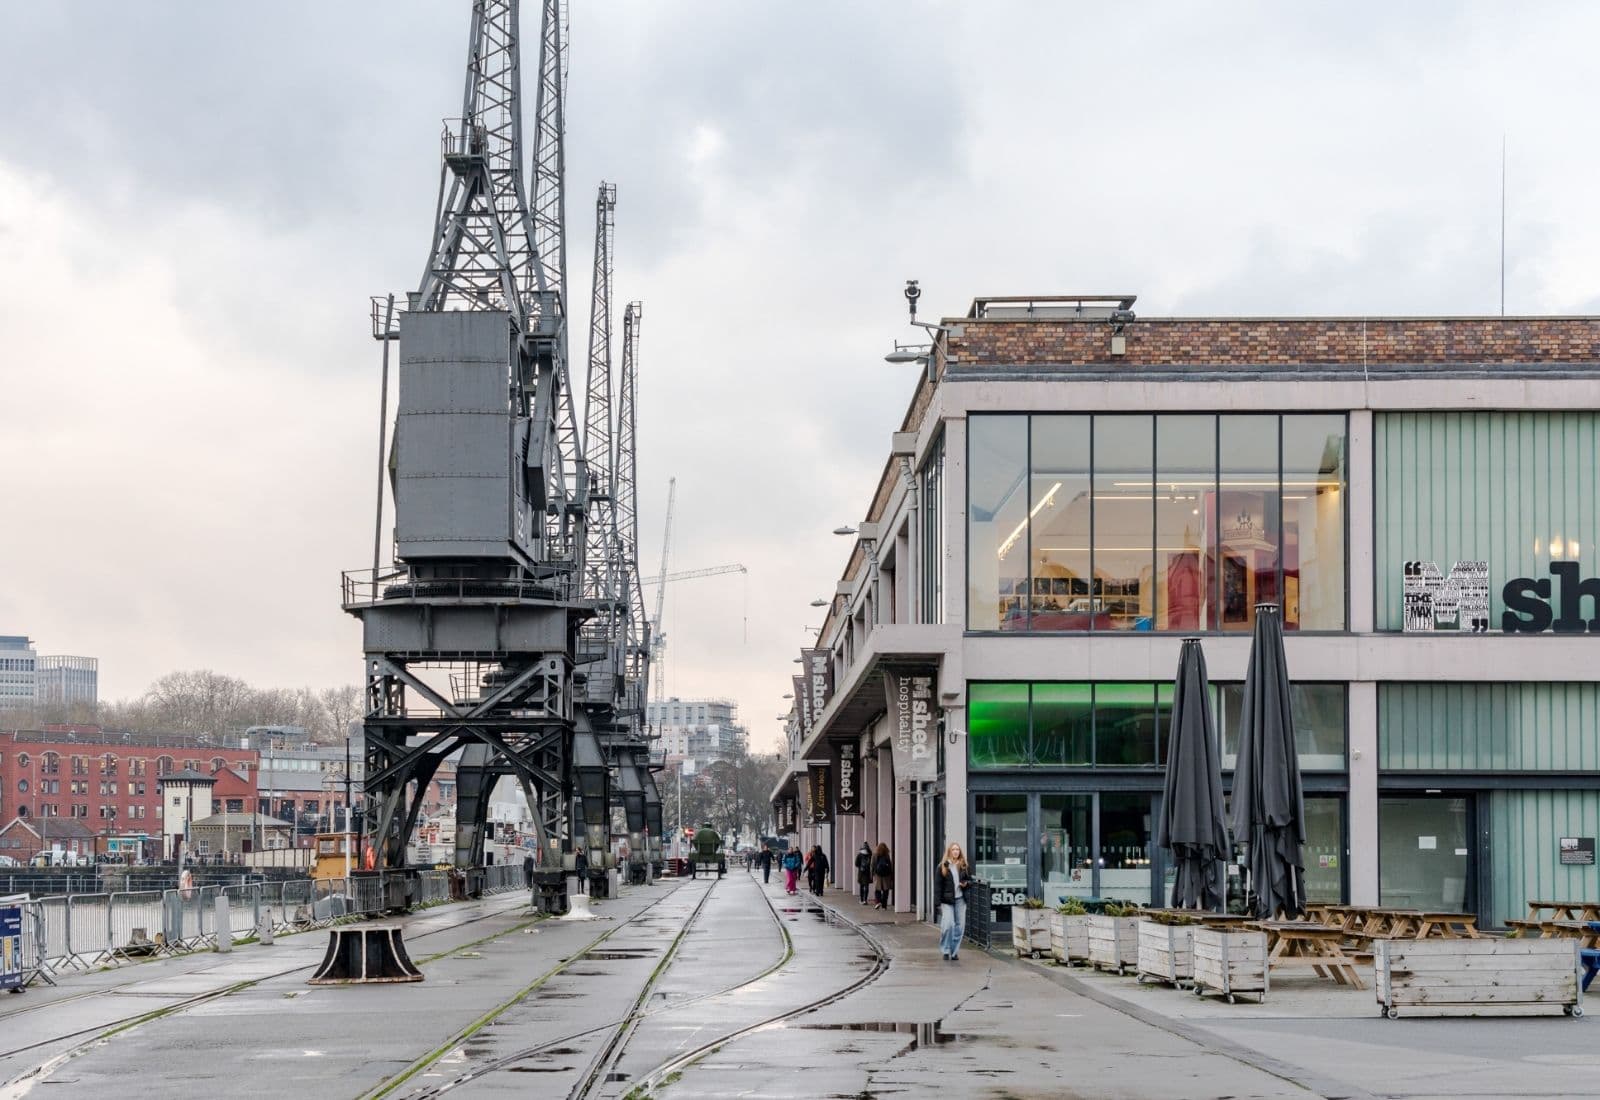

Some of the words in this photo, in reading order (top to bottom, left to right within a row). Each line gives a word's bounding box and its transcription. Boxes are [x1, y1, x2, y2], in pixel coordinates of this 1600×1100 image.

[1502, 561, 1600, 633] sh
[813, 656, 827, 673] M
[912, 677, 932, 698] M
[897, 676, 911, 753] hospitality
[912, 701, 932, 760] shed
[841, 745, 853, 759] M
[841, 760, 853, 798] shed
[816, 785, 825, 808] entry
